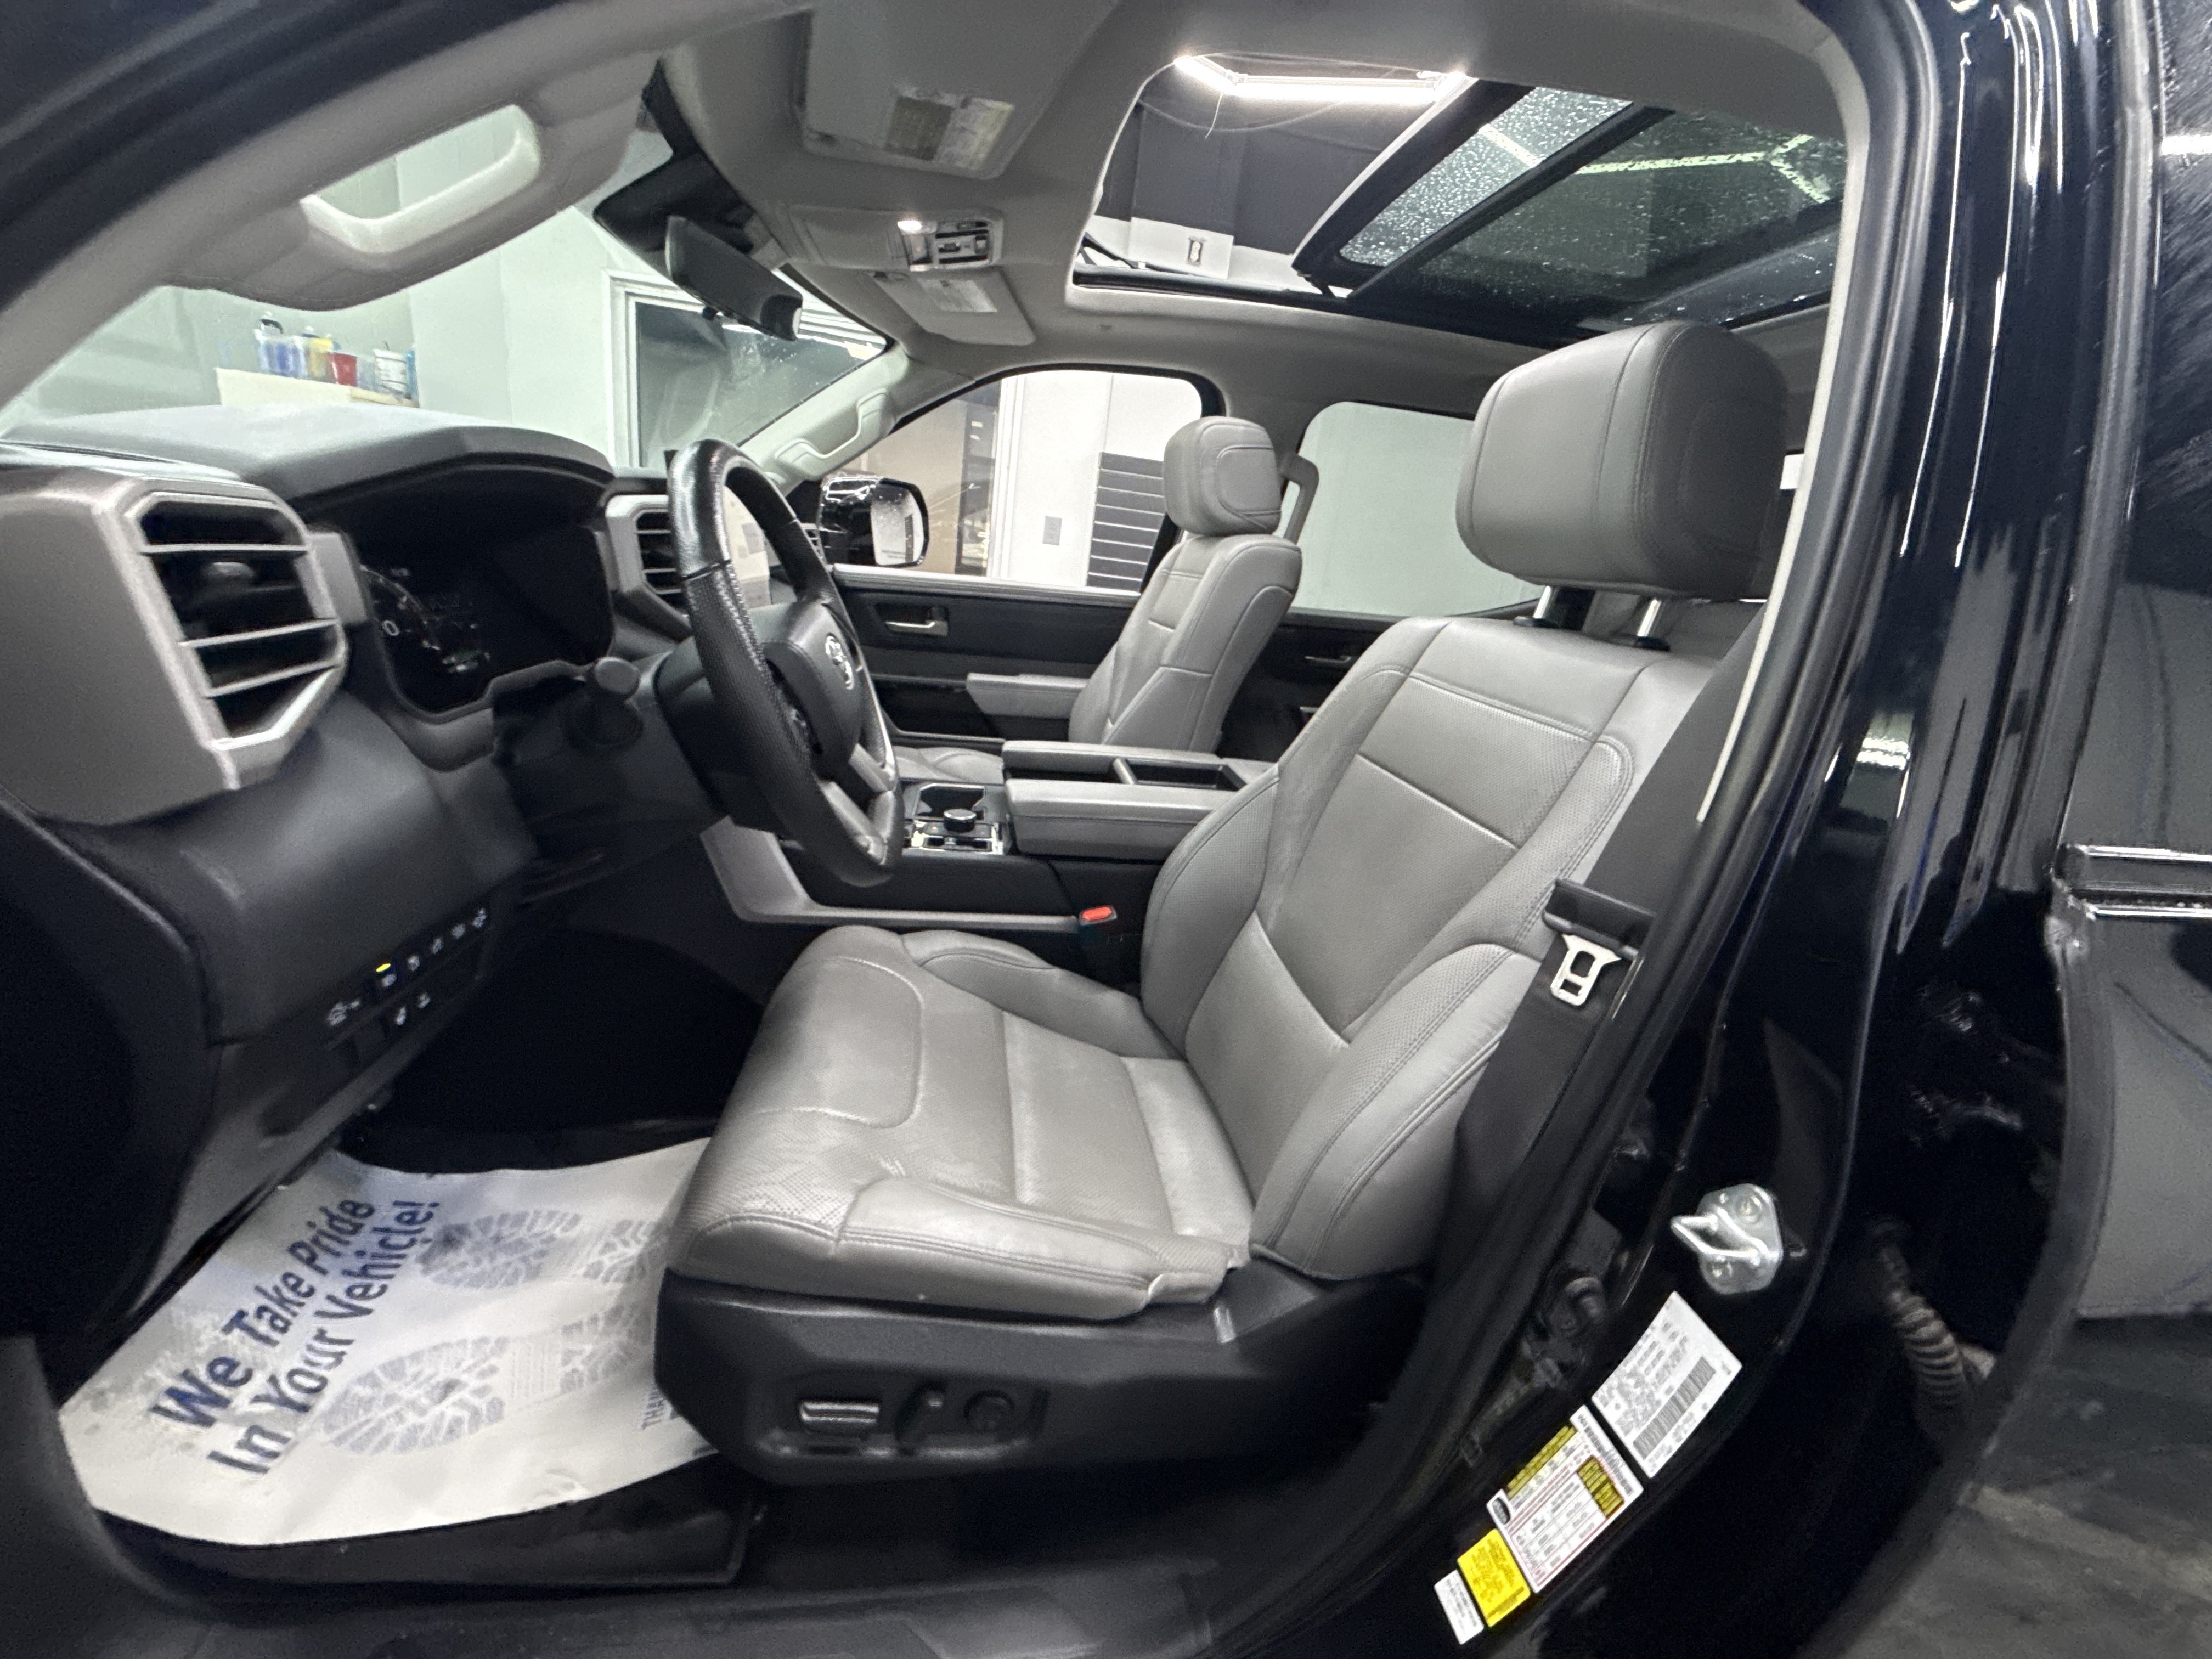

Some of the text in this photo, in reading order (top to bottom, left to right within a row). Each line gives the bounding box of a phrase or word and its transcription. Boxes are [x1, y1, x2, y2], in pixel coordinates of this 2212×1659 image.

[149, 1200, 375, 1427] We Take Pride
[206, 1200, 440, 1474] In Your Vehicle!
